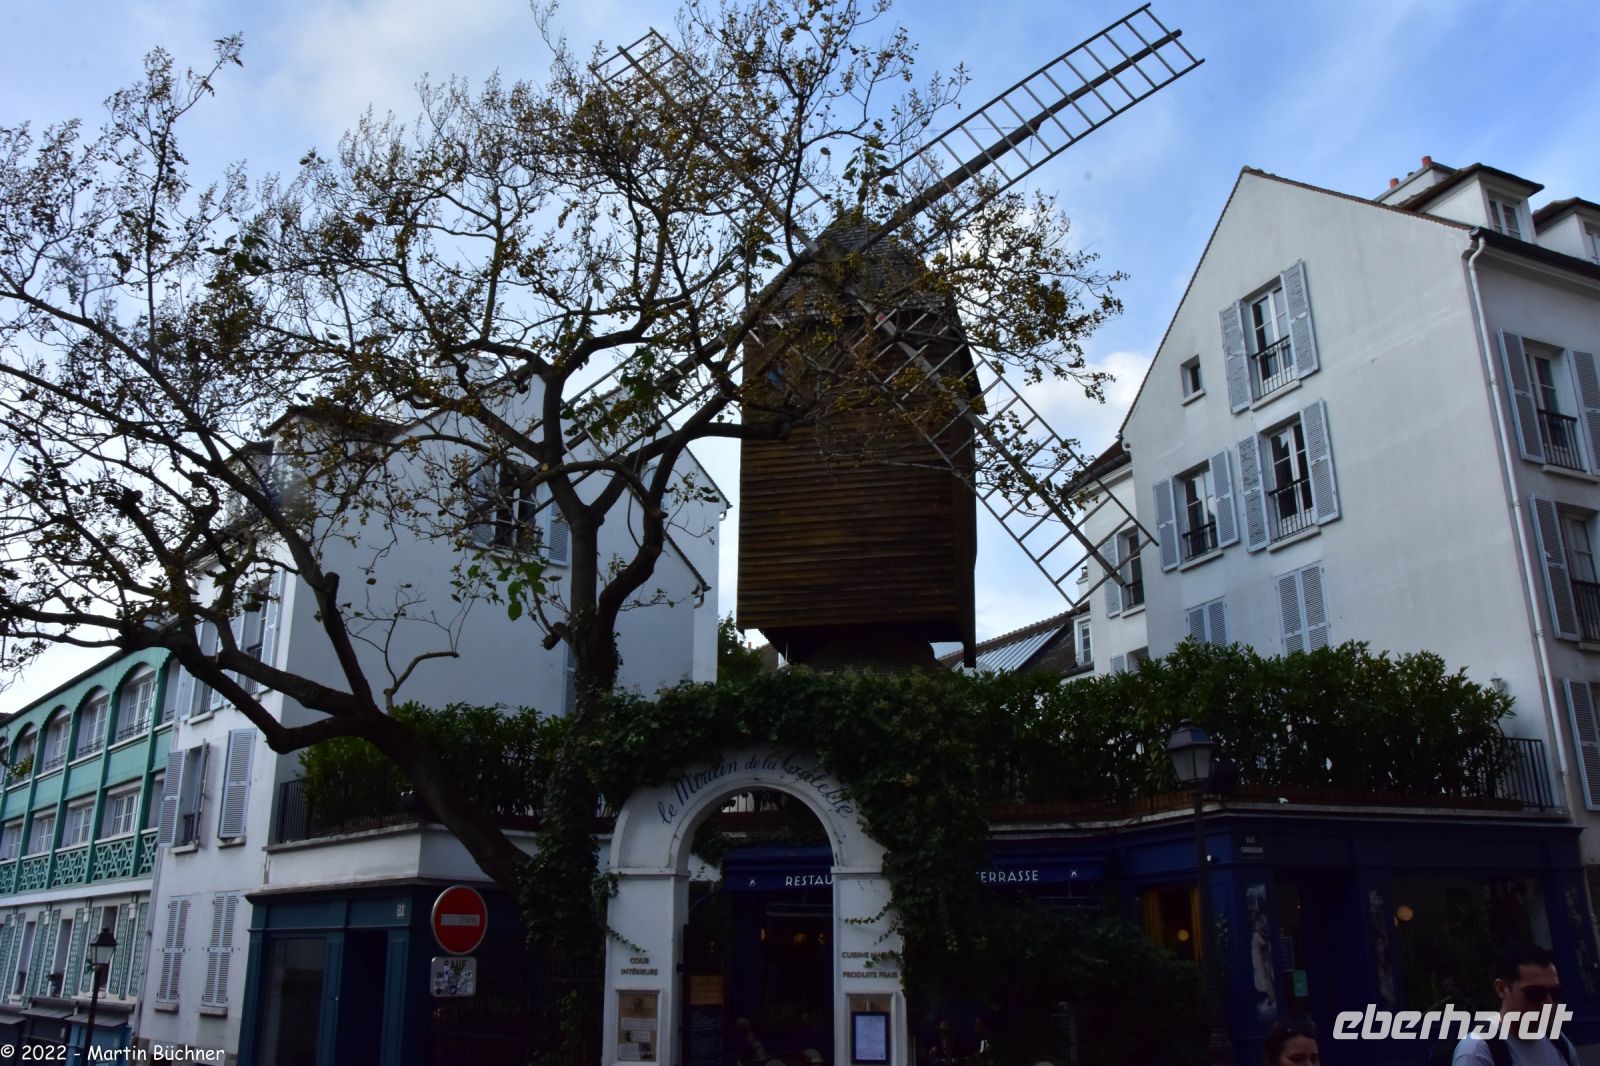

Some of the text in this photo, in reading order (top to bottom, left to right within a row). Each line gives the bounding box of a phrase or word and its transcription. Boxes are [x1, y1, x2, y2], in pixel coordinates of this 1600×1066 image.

[672, 756, 737, 805] Moulin
[744, 754, 759, 770] de
[762, 752, 776, 770] la
[781, 751, 853, 819] Galette
[976, 869, 1038, 883] ERRASSE
